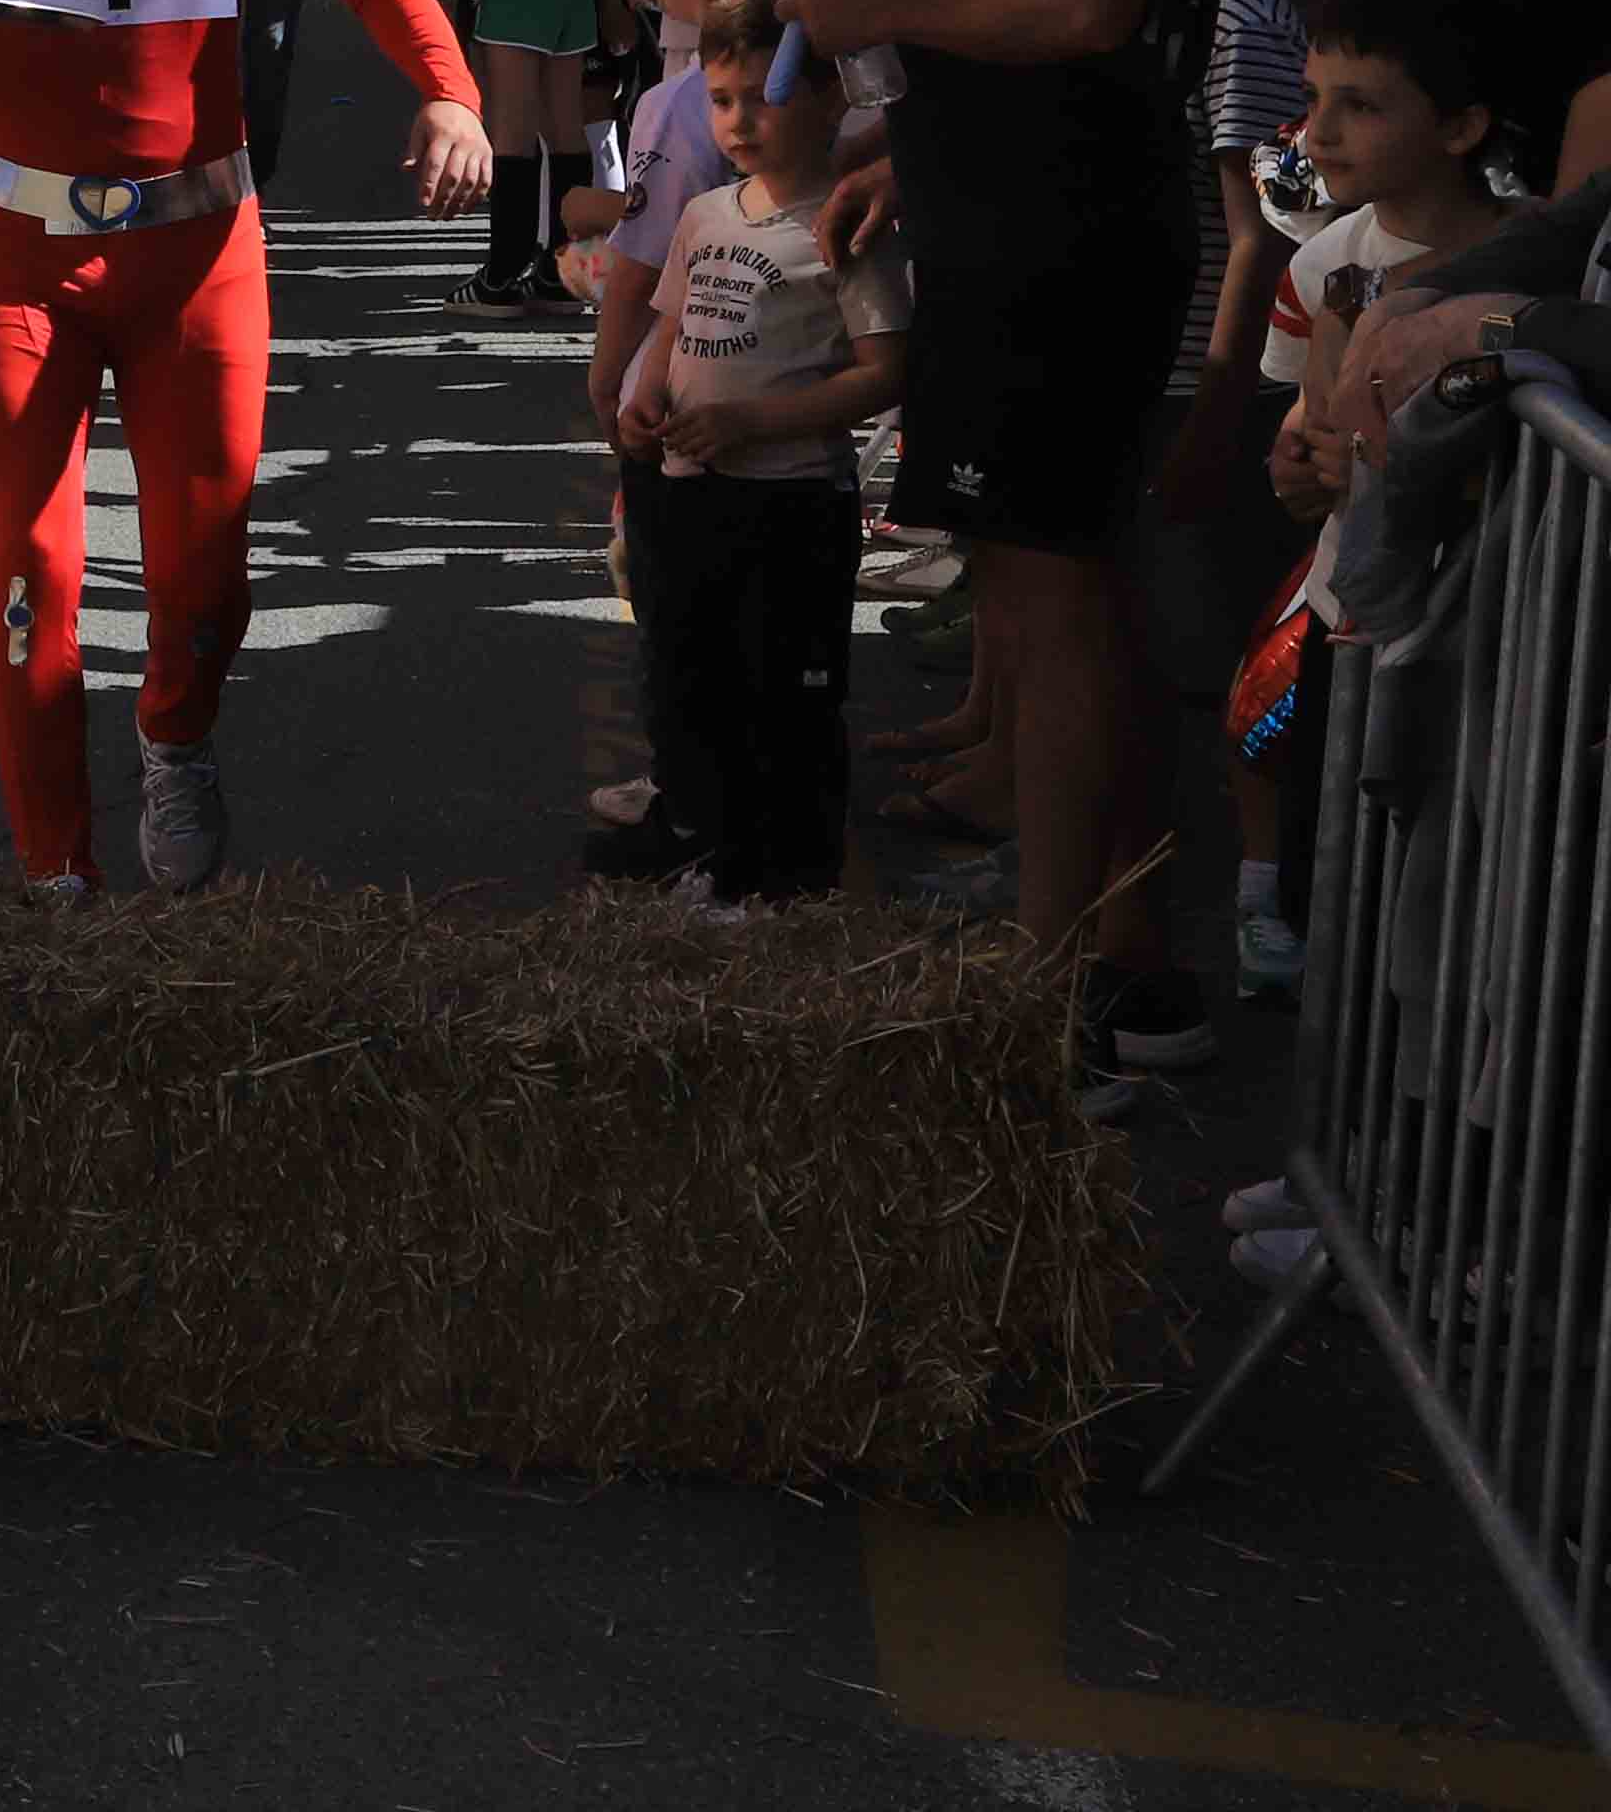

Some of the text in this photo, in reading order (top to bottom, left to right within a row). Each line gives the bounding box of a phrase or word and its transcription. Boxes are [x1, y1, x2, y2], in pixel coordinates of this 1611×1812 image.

[714, 246, 725, 261] &
[729, 243, 788, 293] VOLTAIRE
[713, 276, 756, 294] DROITE
[693, 335, 743, 359] TRUTH
